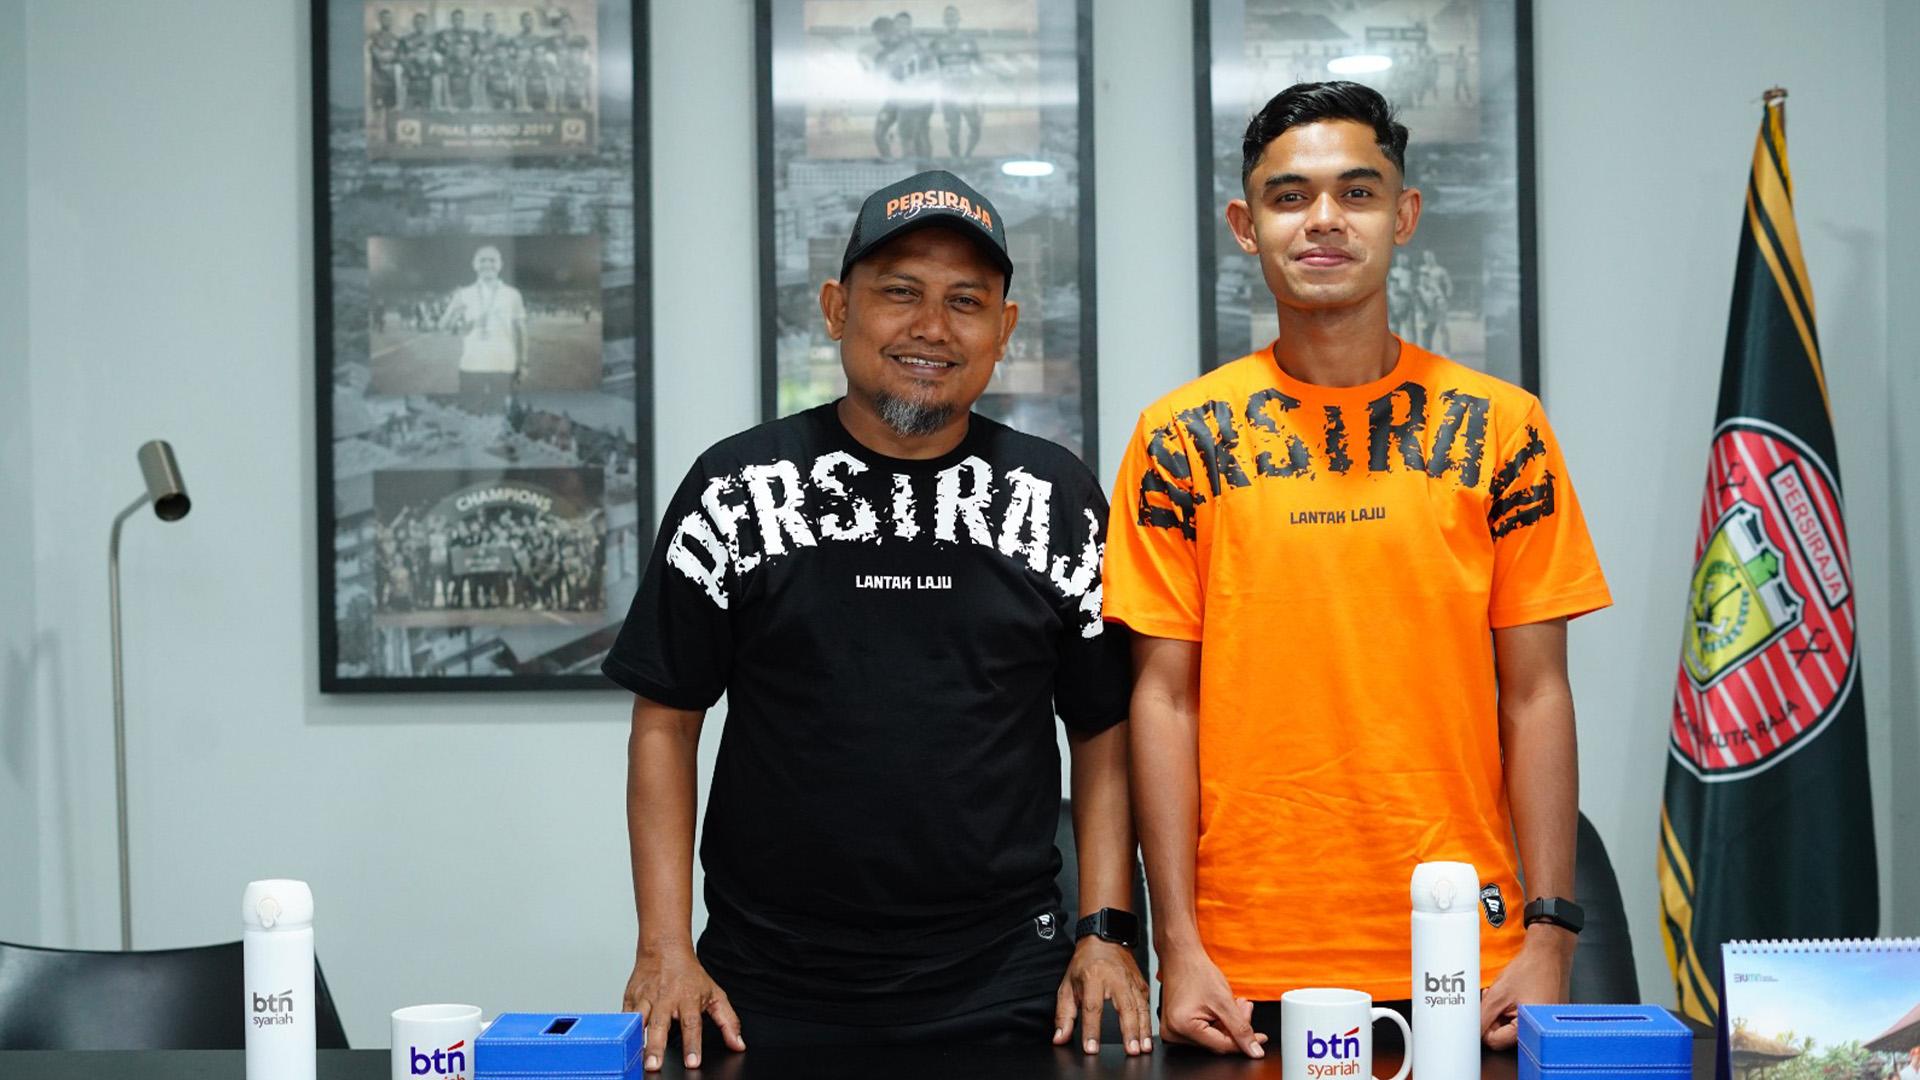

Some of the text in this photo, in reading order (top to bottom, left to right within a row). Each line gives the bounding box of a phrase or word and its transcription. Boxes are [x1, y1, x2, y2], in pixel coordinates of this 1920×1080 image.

[886, 190, 993, 229] PERSIRAJA
[455, 487, 552, 512] CHAMPIONS
[1290, 507, 1386, 525] LANTAK LAJU
[1777, 472, 1842, 600] PERSIRAJA
[855, 575, 952, 590] LANTAK LAJU
[1756, 700, 1799, 738] RAJA
[1425, 993, 1465, 1007] syariah
[252, 1013, 293, 1028] syariah
[1307, 1060, 1360, 1080] syariah
